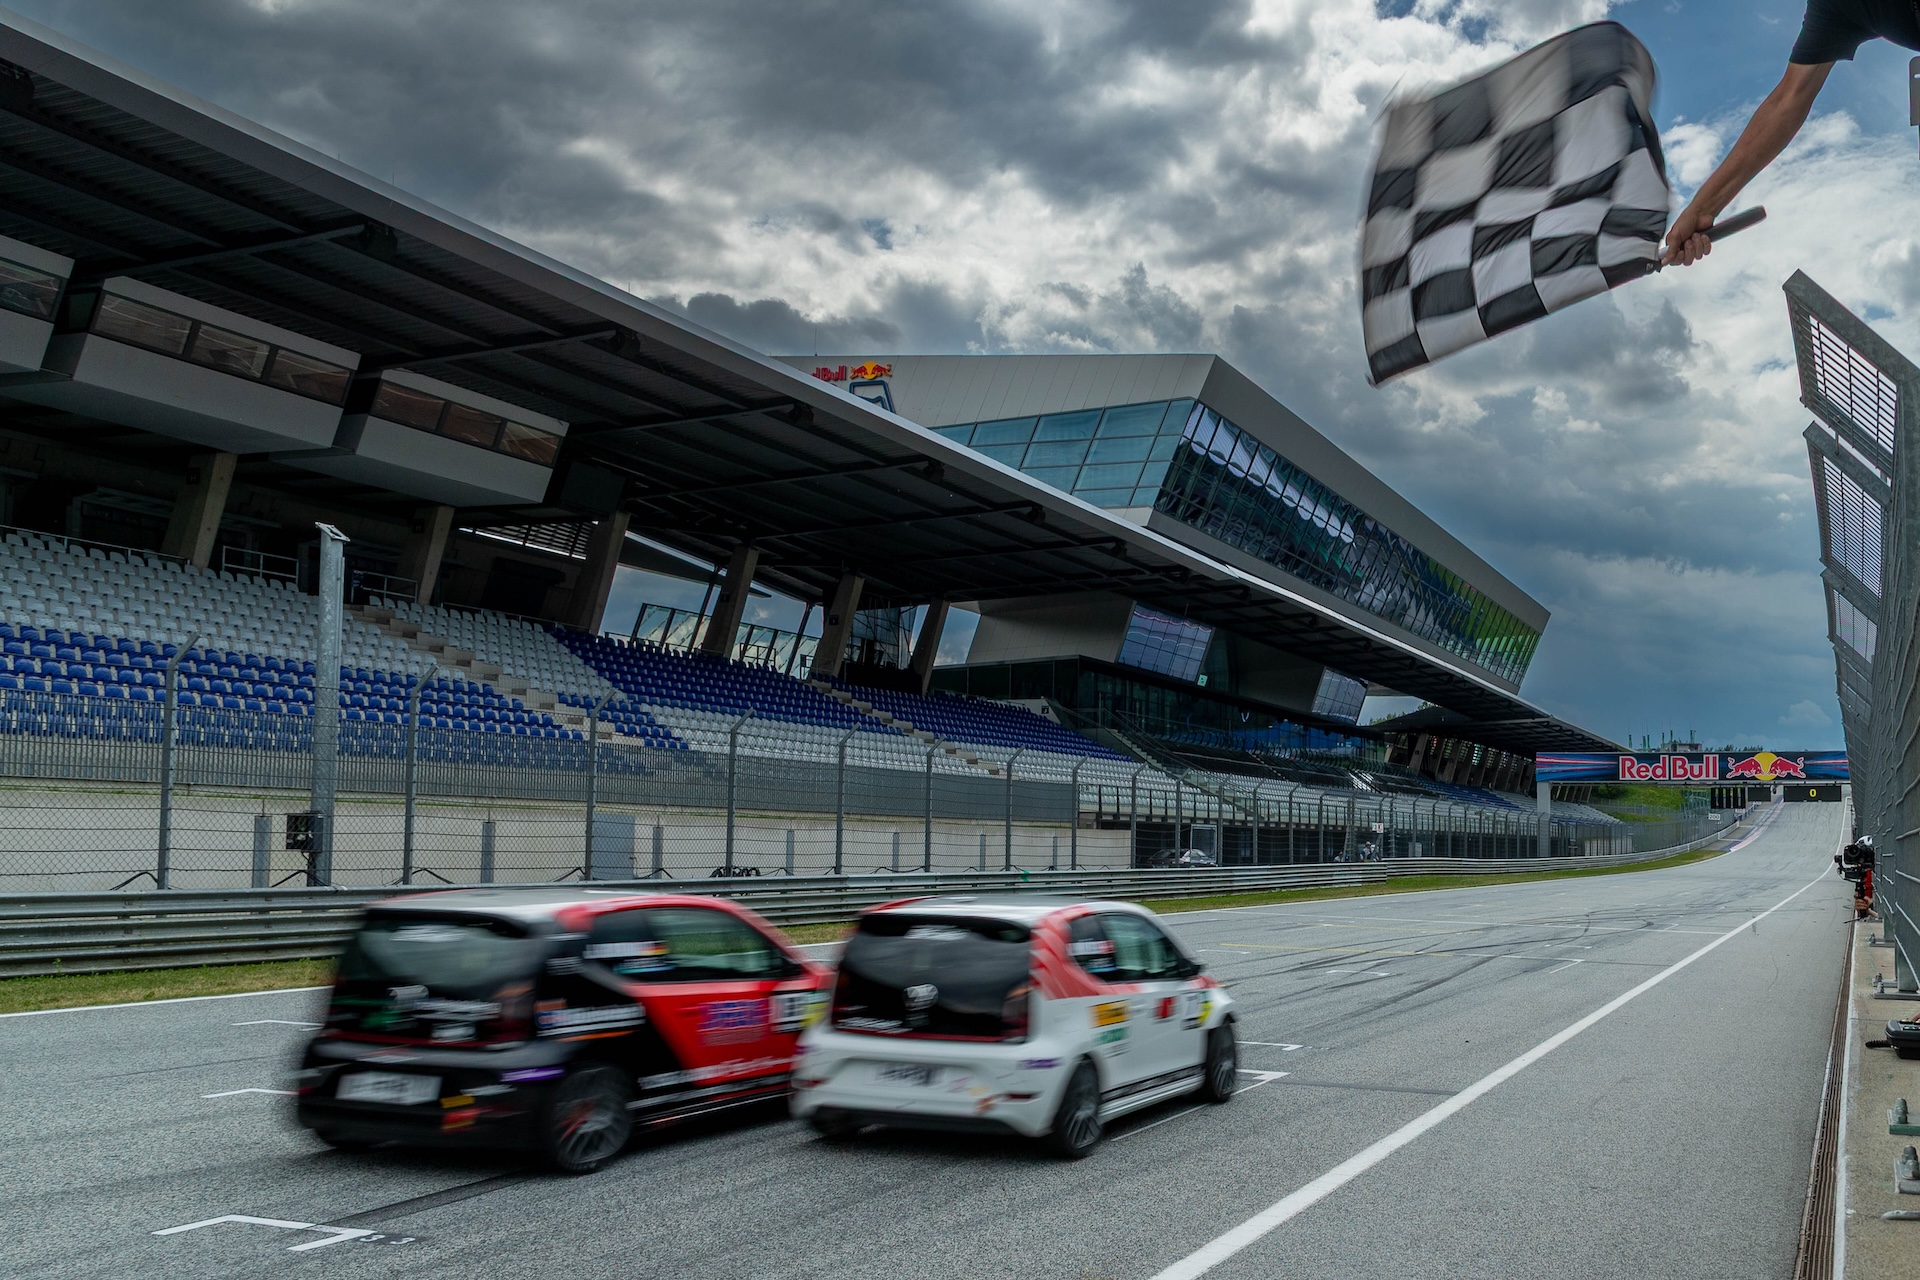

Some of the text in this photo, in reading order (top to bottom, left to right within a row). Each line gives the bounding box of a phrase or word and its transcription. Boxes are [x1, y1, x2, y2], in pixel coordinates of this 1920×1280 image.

[821, 365, 846, 381] Bull
[1620, 754, 1719, 780] Red Bull
[1809, 788, 1817, 798] 0
